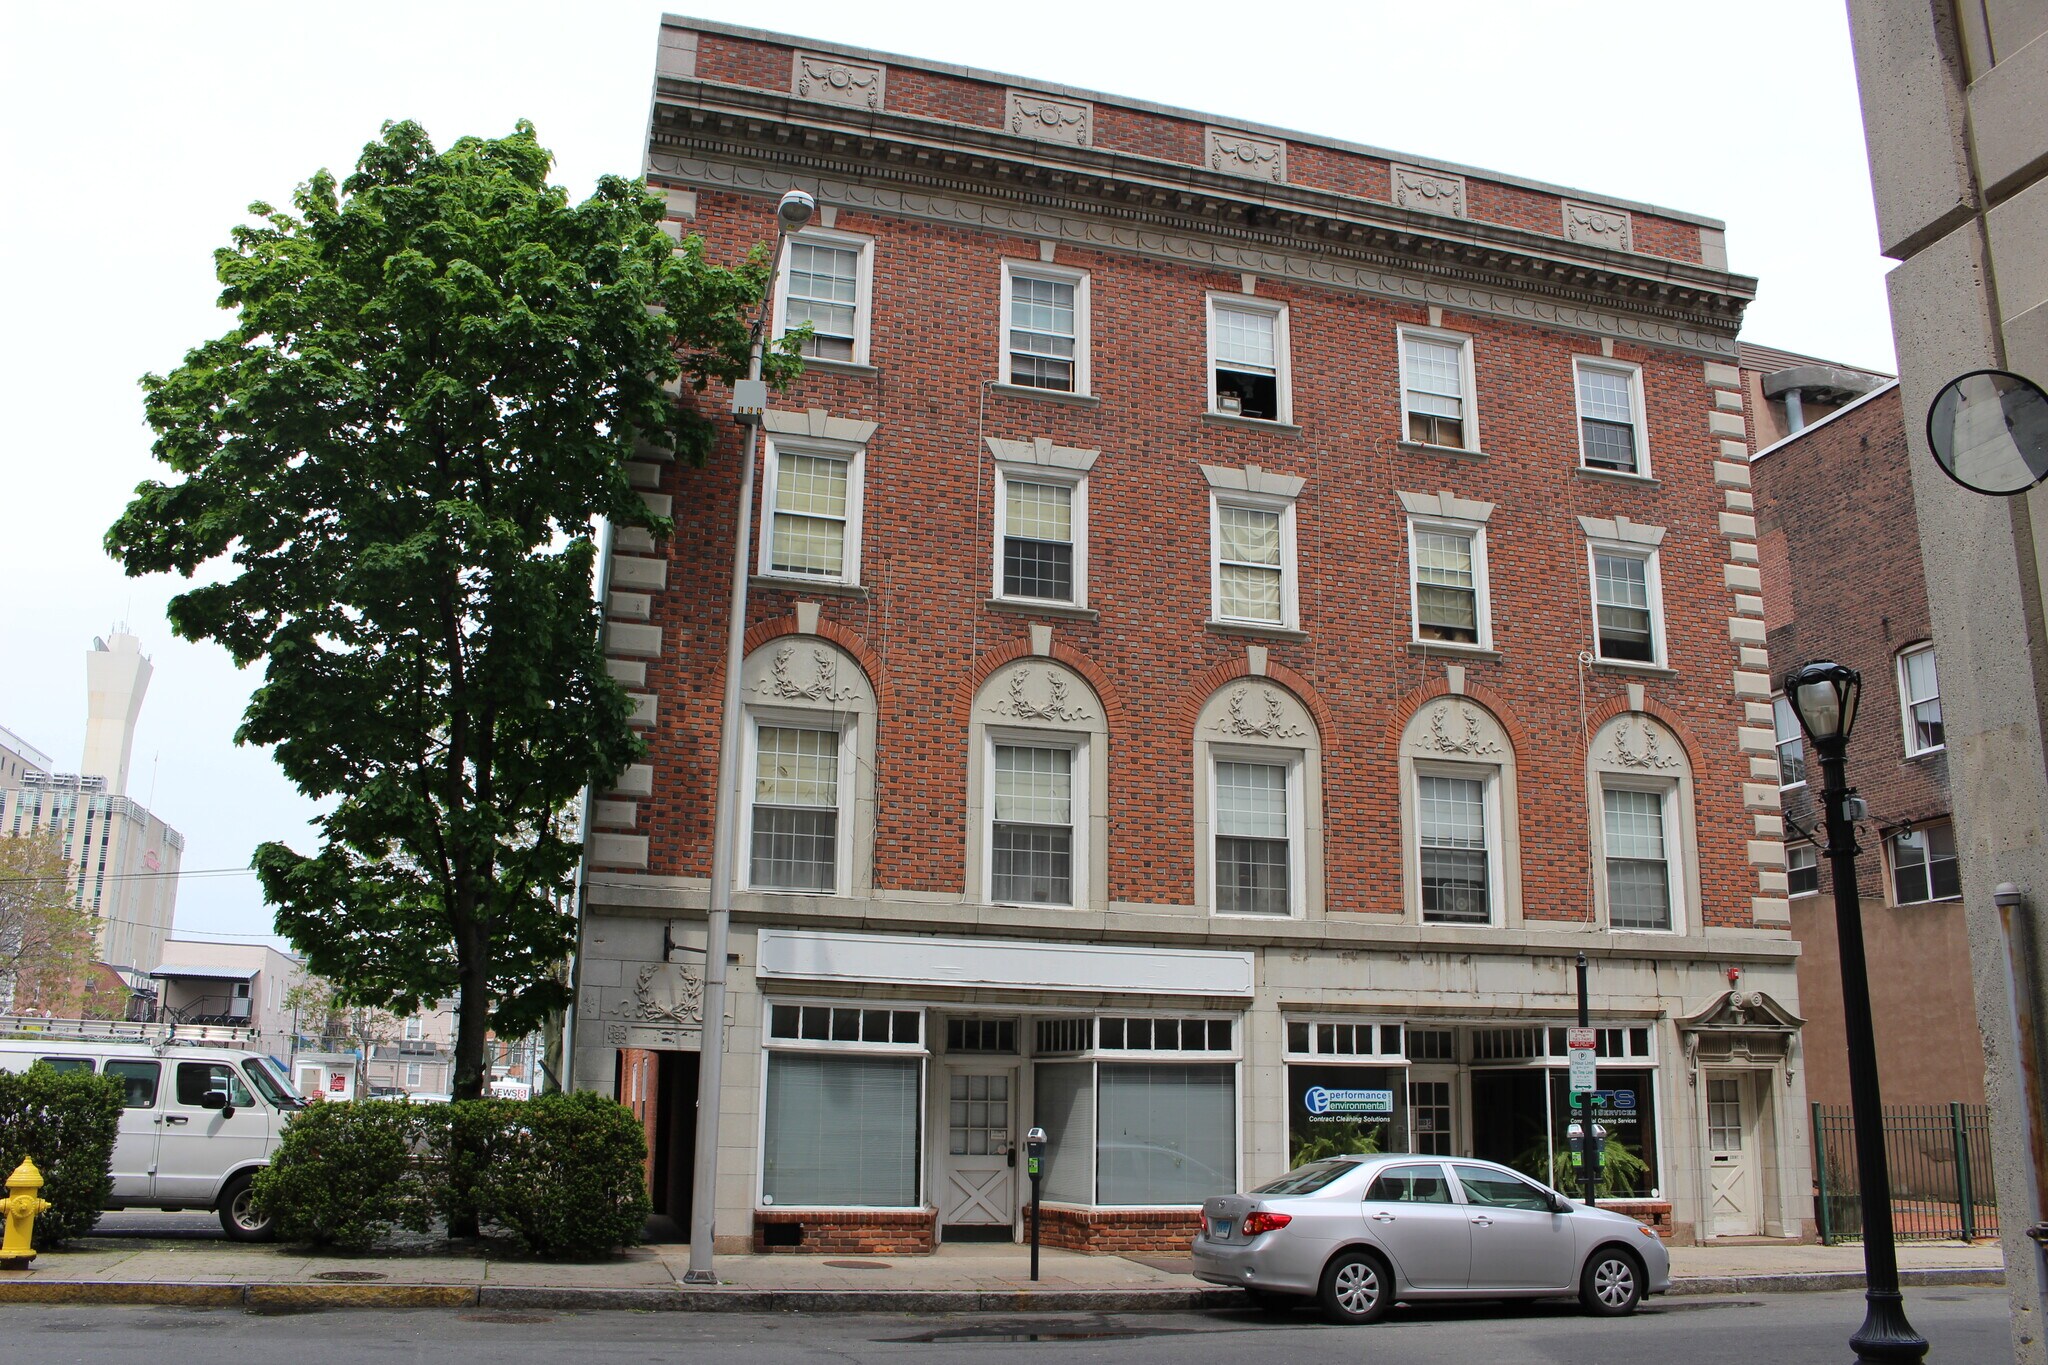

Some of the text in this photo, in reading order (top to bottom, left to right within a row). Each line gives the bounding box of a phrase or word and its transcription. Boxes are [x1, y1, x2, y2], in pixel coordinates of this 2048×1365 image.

[490, 1088, 518, 1098] NEWS
[1329, 1091, 1387, 1100] performance
[1330, 1101, 1386, 1110] environmental
[1336, 1115, 1362, 1123] Cleaning
